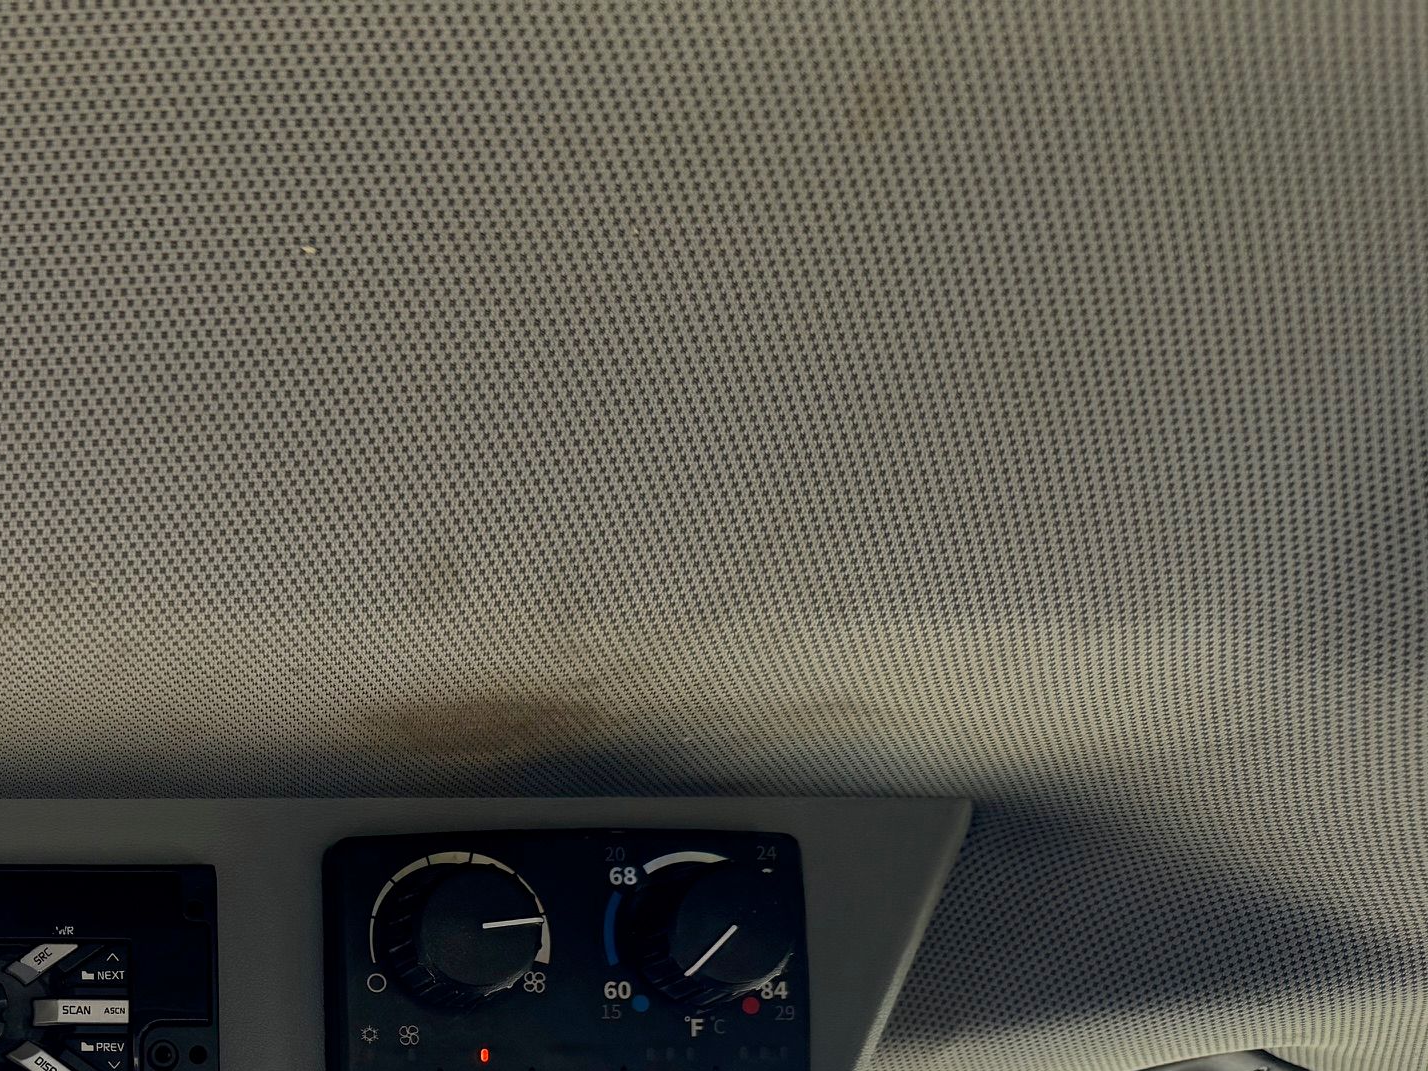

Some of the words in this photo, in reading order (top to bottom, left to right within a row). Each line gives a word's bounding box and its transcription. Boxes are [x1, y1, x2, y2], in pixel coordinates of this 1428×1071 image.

[604, 846, 626, 862] 20
[756, 845, 777, 861] 24
[608, 866, 638, 886] 68
[33, 947, 53, 966] SRC
[97, 970, 125, 980] NEXT
[603, 981, 632, 1000] 60
[760, 980, 789, 1000] 84
[62, 1005, 91, 1015] SCAN
[103, 1007, 126, 1015] ASCN
[601, 1004, 622, 1020] 15
[774, 1005, 796, 1021] 29
[96, 1042, 125, 1052] PREV
